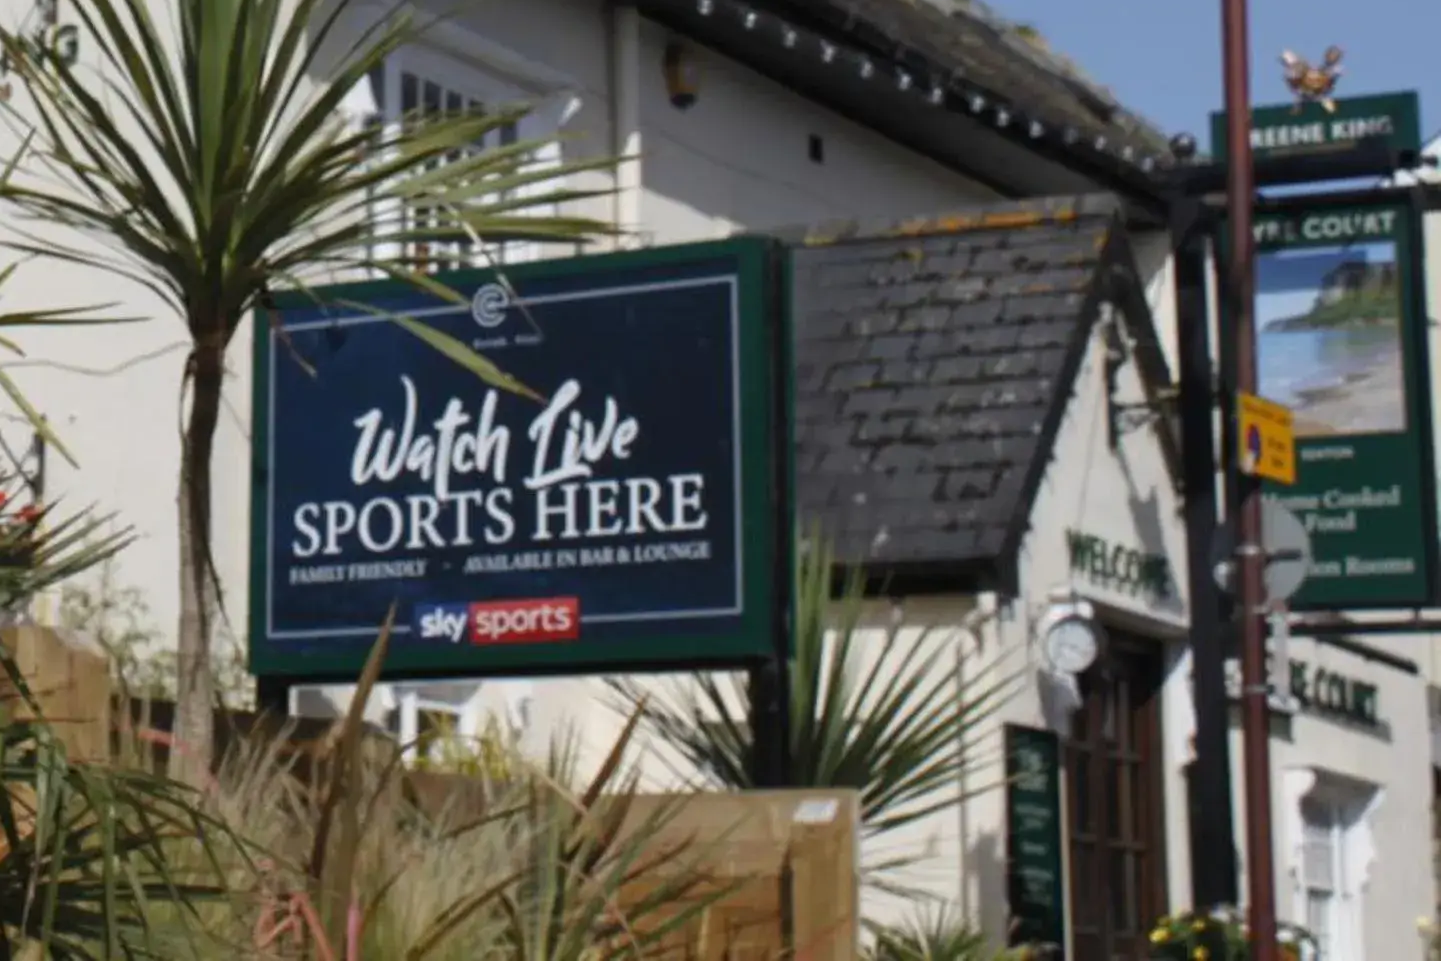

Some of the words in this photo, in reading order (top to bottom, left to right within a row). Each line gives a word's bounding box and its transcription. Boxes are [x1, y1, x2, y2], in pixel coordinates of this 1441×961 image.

[1249, 121, 1325, 148] REENE
[1302, 209, 1397, 240] COURT
[351, 374, 510, 502] Watch
[523, 378, 640, 490] Live
[292, 486, 515, 558] SPORTS
[532, 473, 708, 541] HERE
[289, 565, 345, 585] FAMILY
[348, 559, 428, 581] FRIENDLY
[463, 550, 555, 574] AVAILABLE
[557, 548, 578, 568] IN
[580, 547, 615, 567] BAR
[617, 547, 631, 563] &
[634, 542, 711, 562] LOUNGE
[419, 607, 468, 643] sky
[474, 603, 572, 640] sports
